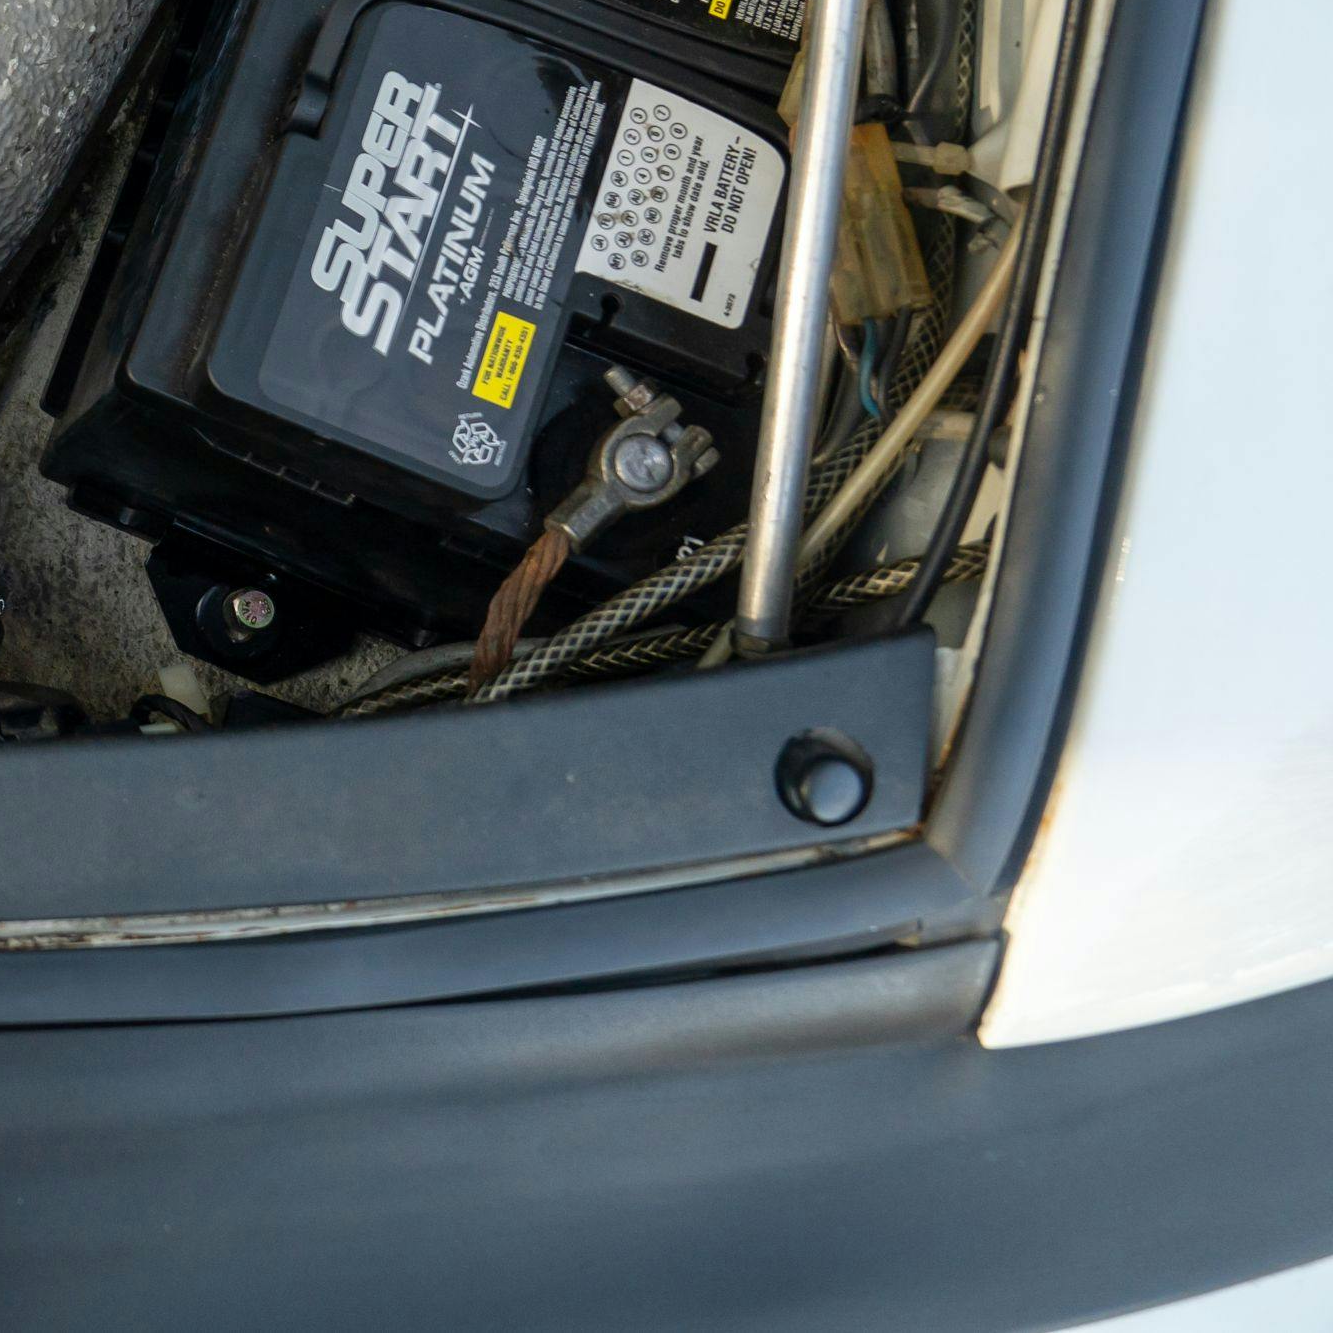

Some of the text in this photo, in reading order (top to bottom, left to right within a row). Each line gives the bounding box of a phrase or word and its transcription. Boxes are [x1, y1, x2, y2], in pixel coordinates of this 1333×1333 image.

[713, 0, 725, 14] DO
[310, 70, 424, 304] SUPER
[514, 135, 546, 205] Springfield MO 65802
[654, 135, 703, 272] Remove proper month and year
[671, 160, 709, 258] tabs to show date sold.
[703, 144, 740, 232] VRLA BATTERY
[720, 146, 756, 233] DO NOT OPEN!
[330, 78, 475, 356] START
[407, 152, 495, 364] PLATINUM
[459, 245, 485, 299] AGM
[462, 330, 484, 369] Automotive
[492, 254, 508, 275] South
[481, 326, 506, 385] FOR NATIONWIDE
[495, 339, 512, 378] WARRANTY
[499, 383, 511, 400] CALL
